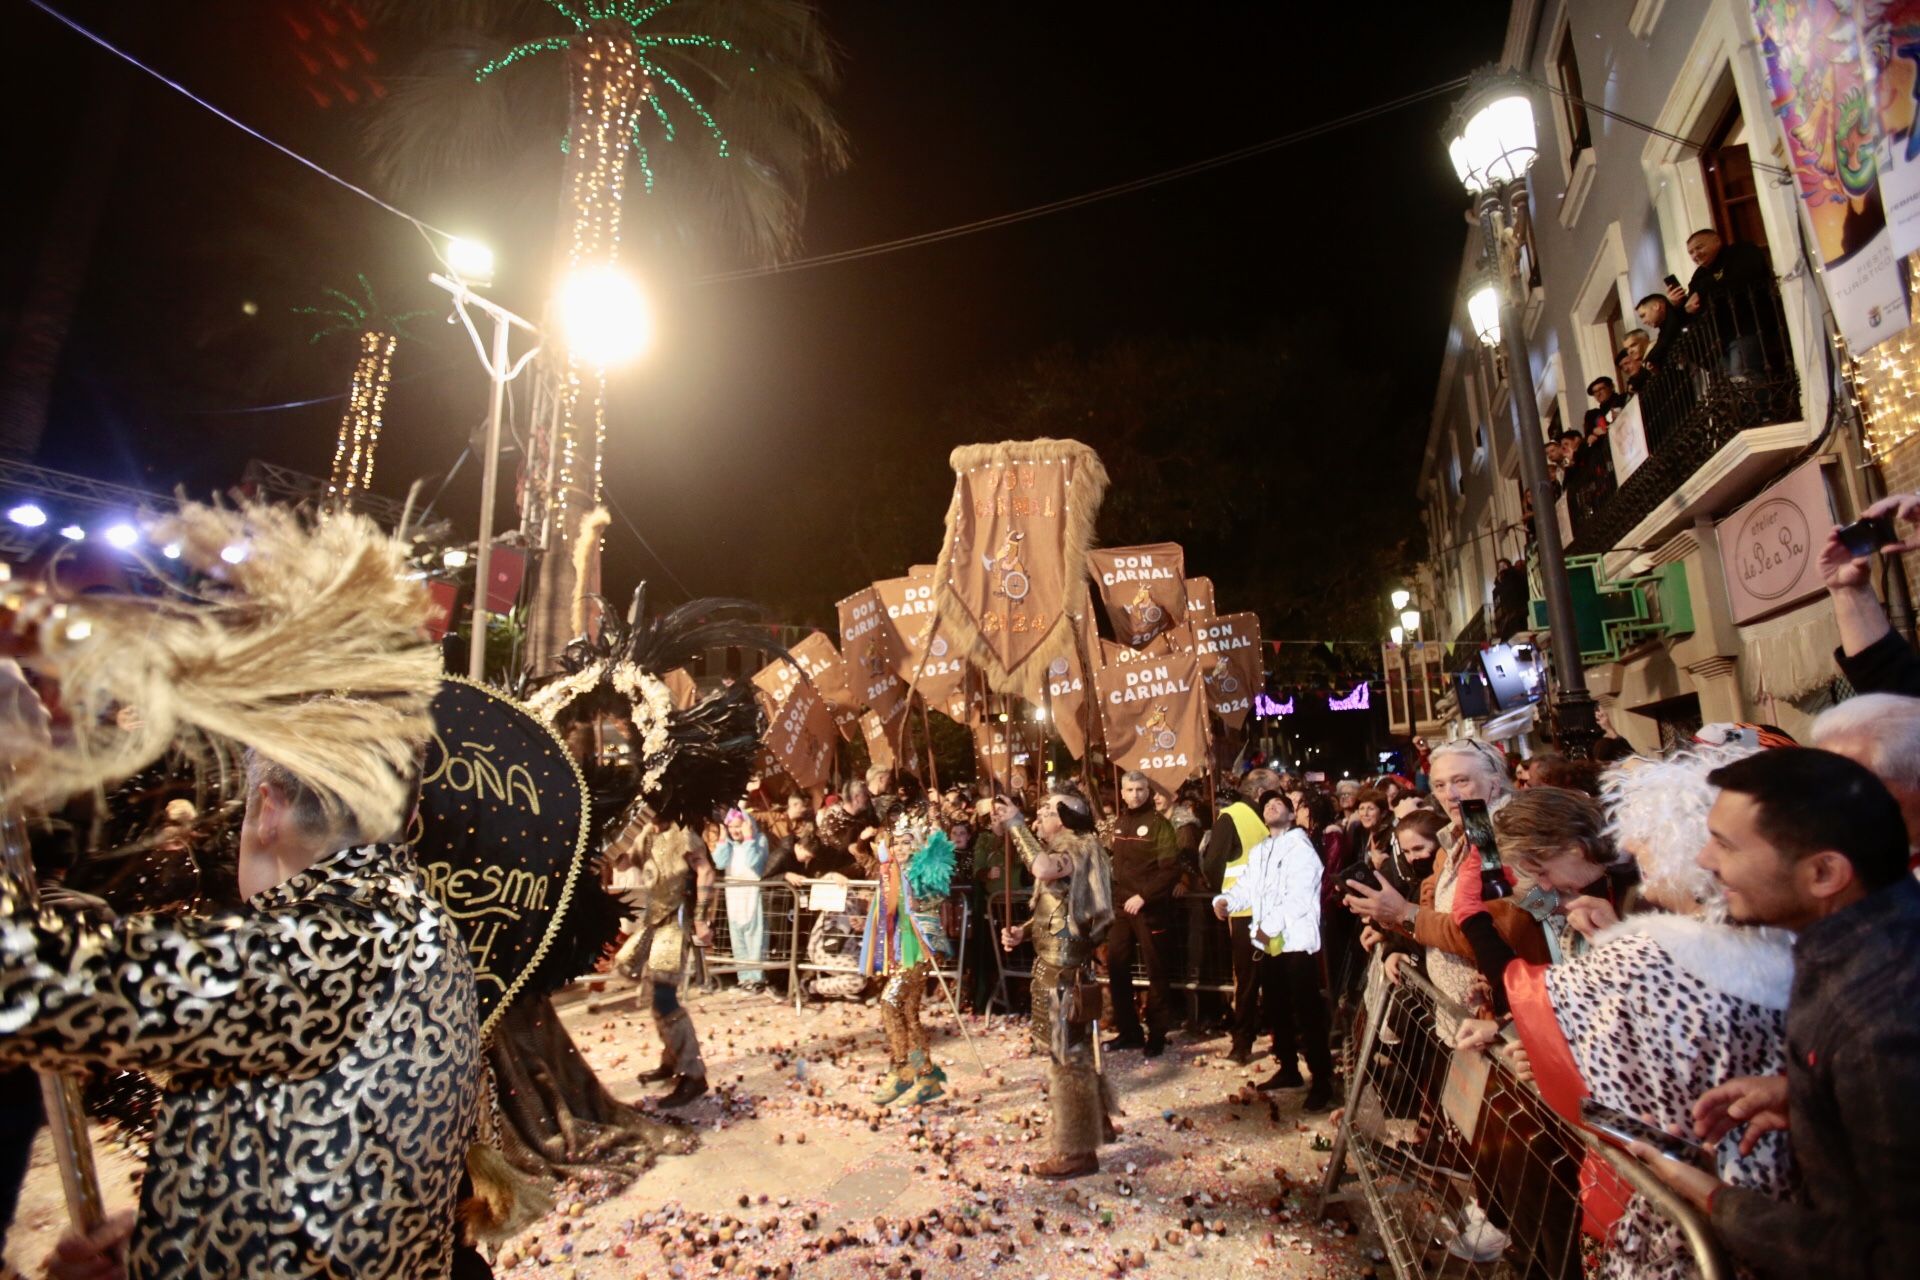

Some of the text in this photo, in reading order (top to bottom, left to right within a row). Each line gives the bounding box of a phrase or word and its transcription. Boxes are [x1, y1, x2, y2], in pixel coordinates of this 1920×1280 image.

[1114, 555, 1152, 569] DON
[1103, 567, 1174, 586] CARNAL
[905, 586, 931, 602] DO
[1197, 624, 1233, 641] DON
[1126, 666, 1168, 686] DON
[867, 675, 898, 700] 2024
[1049, 678, 1083, 696] 024
[1110, 679, 1190, 704] CARNAL
[1139, 753, 1188, 769] 2024
